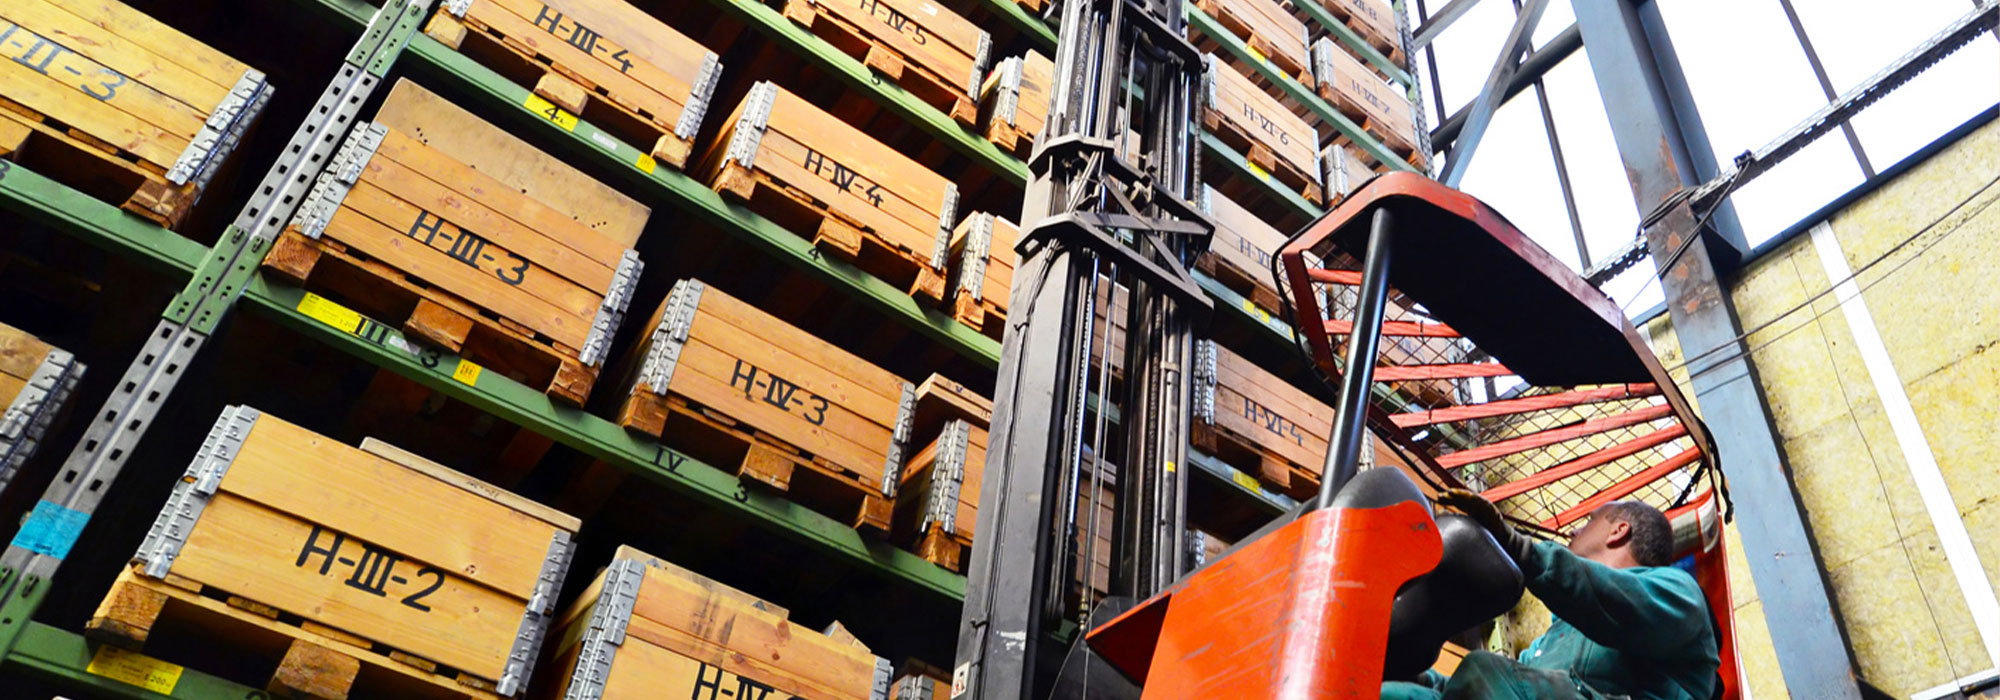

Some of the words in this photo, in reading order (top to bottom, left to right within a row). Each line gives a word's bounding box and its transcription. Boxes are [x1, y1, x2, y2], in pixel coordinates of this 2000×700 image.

[534, 4, 634, 74] H-III-4
[859, 0, 926, 45] H-IV-5
[0, 23, 127, 102] -II-3
[1243, 103, 1289, 145] H-VI-6
[804, 149, 884, 208] H-IV-4
[408, 210, 530, 285] H-III-3
[808, 246, 820, 260] 4
[349, 315, 396, 348] III
[420, 350, 440, 369] 3
[730, 358, 829, 426] H-IV-3
[1244, 398, 1303, 447] H-VI-4
[650, 445, 689, 478] IV
[734, 481, 750, 503] 3
[296, 525, 445, 613] H-III-2
[692, 661, 809, 700] H-IV-
